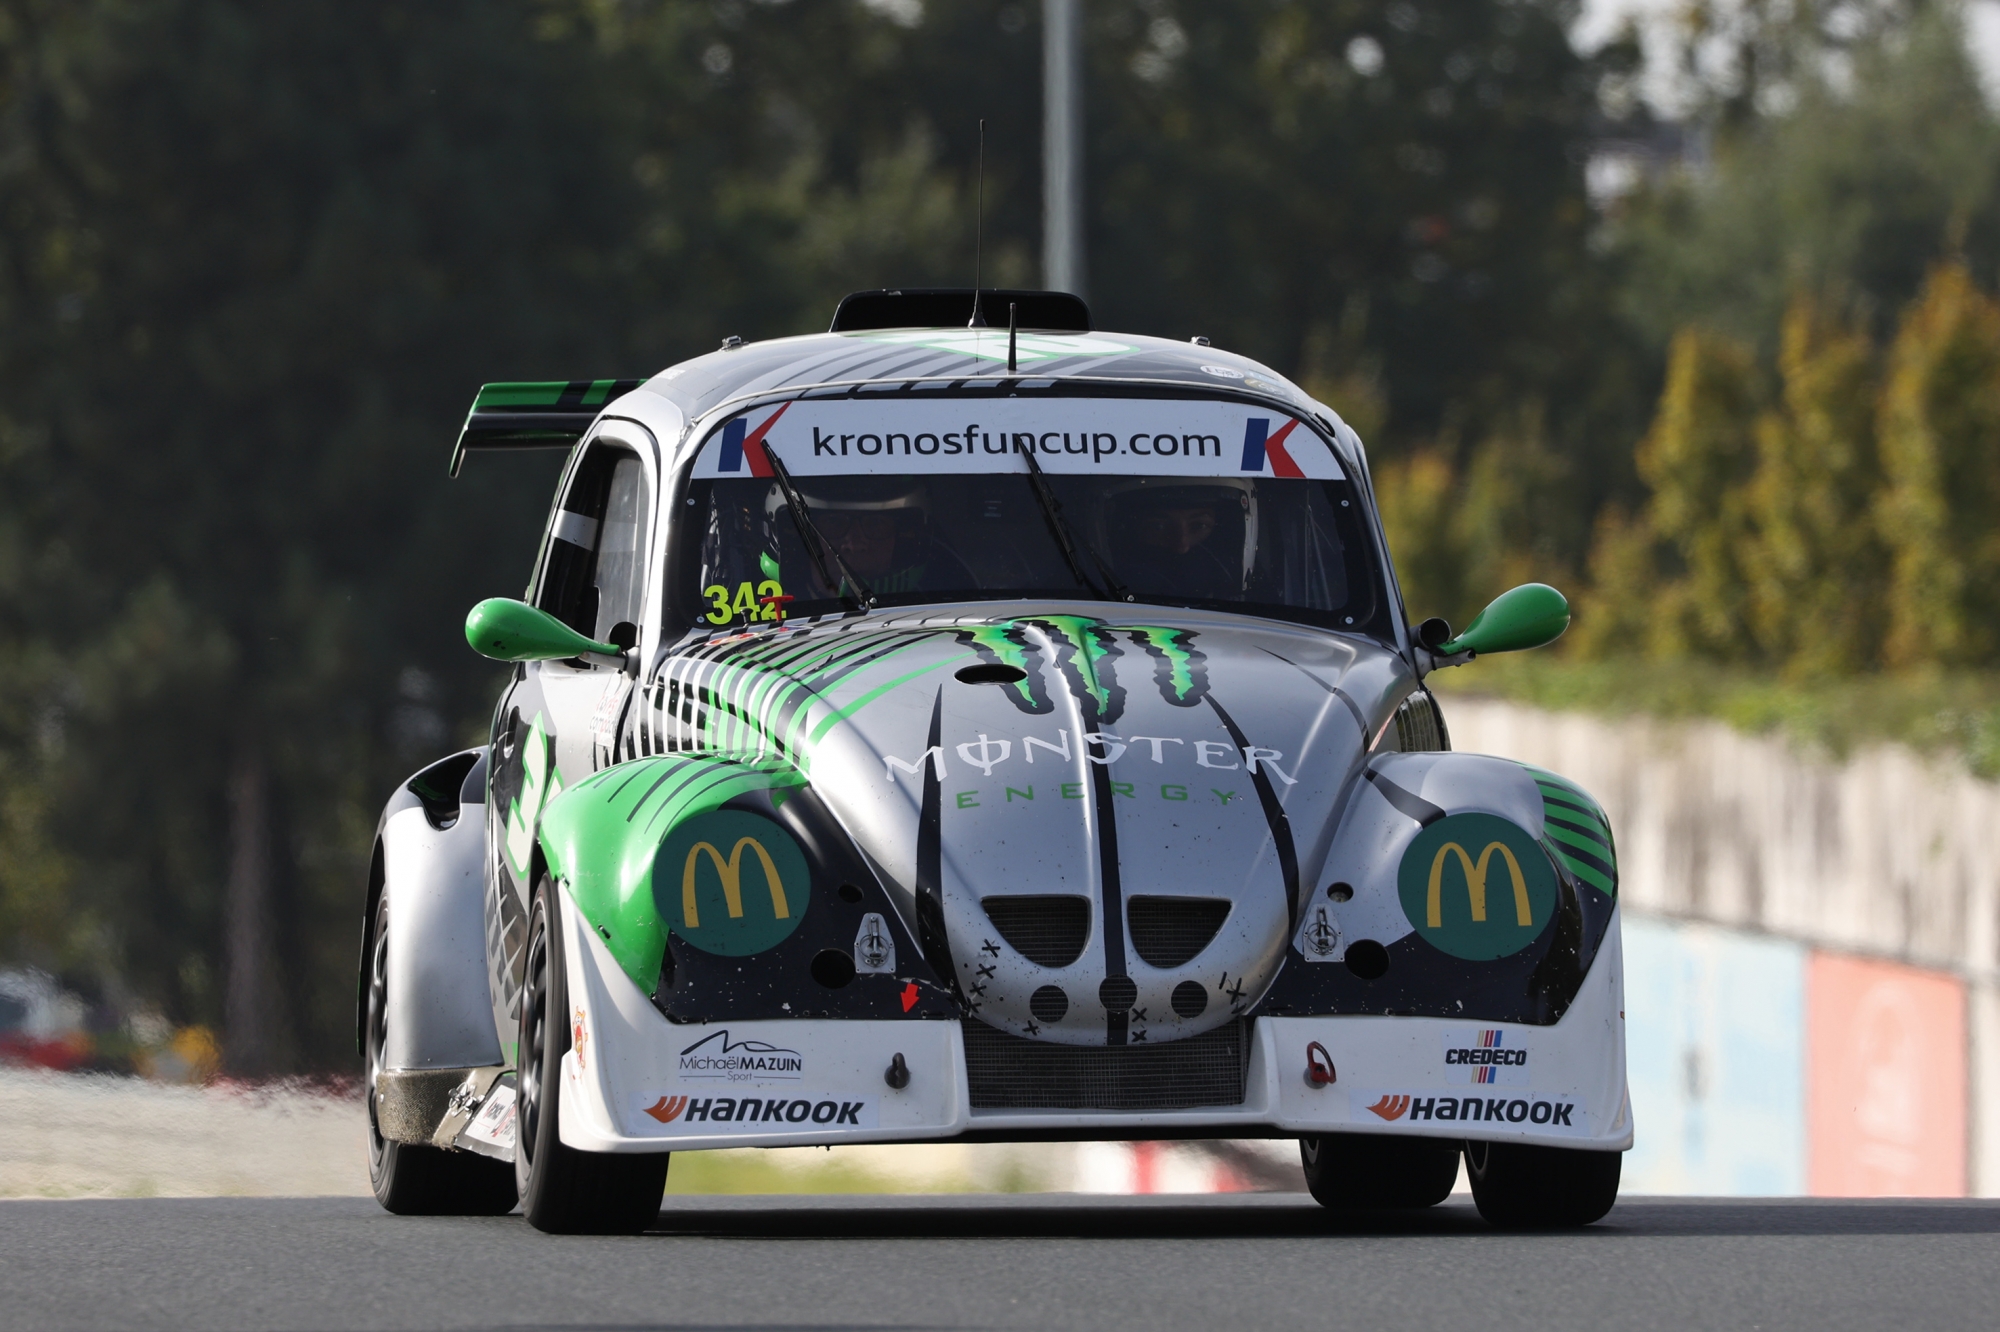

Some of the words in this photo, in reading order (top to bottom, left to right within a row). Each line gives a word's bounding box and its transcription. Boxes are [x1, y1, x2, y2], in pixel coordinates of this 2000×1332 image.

[813, 425, 1222, 463] kronosfuncup.com
[704, 580, 787, 625] 342
[956, 781, 1236, 809] ENERGY
[1445, 1048, 1527, 1066] CREDECO
[727, 1070, 752, 1082] Sport
